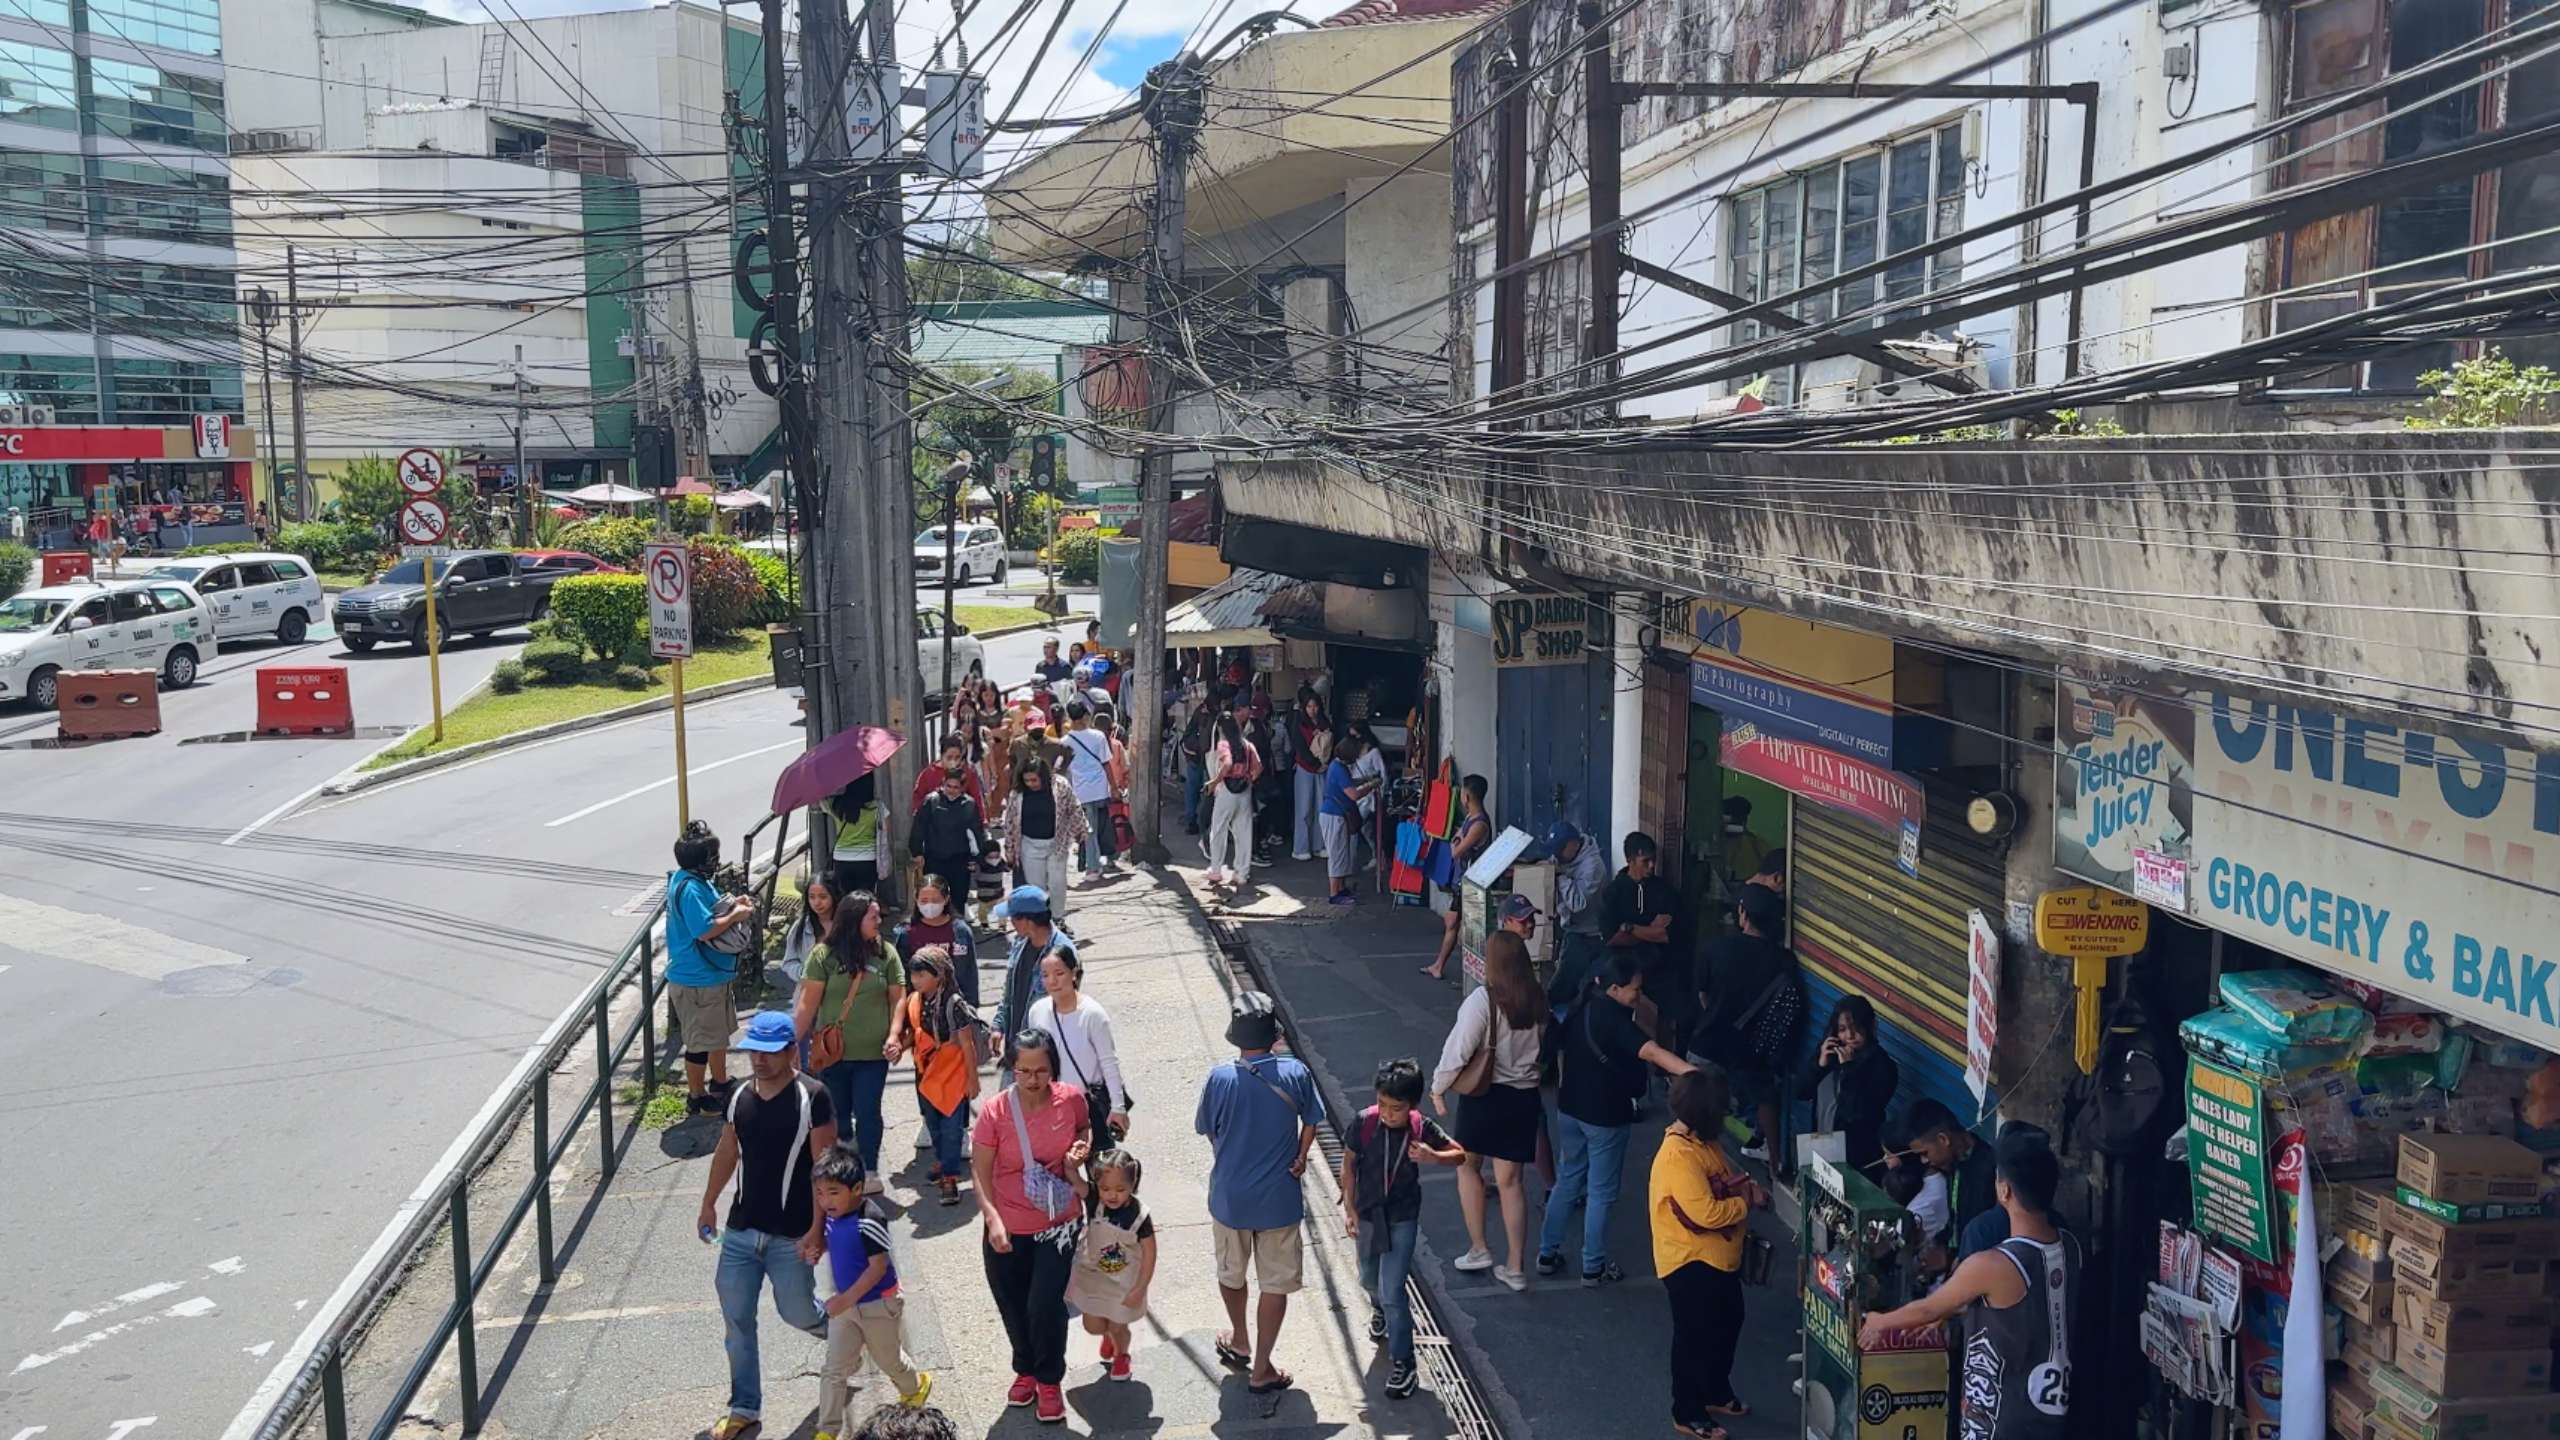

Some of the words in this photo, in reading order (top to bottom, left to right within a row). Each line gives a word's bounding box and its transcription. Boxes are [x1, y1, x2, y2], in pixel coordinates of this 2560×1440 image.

[664, 609, 676, 622] NO
[1535, 597, 1585, 625] BARBER
[654, 626, 688, 641] PARKING
[1494, 598, 1532, 660] SP
[1536, 629, 1584, 657] SHOP
[1712, 669, 1792, 712] Photography
[1731, 724, 1756, 746] RUSH
[1818, 726, 1855, 747] DIGITALLY
[1856, 737, 1889, 758] PERFECT
[1759, 732, 1835, 781] TARPAULIN
[1838, 760, 1908, 814] PRINTING
[2076, 735, 2163, 796] Tender
[2086, 783, 2154, 848] Juicy
[2056, 896, 2078, 905] CUT
[2111, 898, 2139, 907] HERE
[2073, 913, 2141, 931] WENXING
[2069, 944, 2118, 952] MACHINES
[2208, 856, 2390, 964] GROCERY
[2404, 920, 2434, 983] &
[2452, 933, 2560, 1028] BAK
[2191, 1092, 2221, 1120] SALES
[2223, 1106, 2252, 1132] LADY
[2190, 1113, 2215, 1139] MALE
[2217, 1125, 2257, 1157] HELPER
[2205, 1141, 2241, 1171] BAKER
[1804, 1287, 1849, 1347] PAULIN
